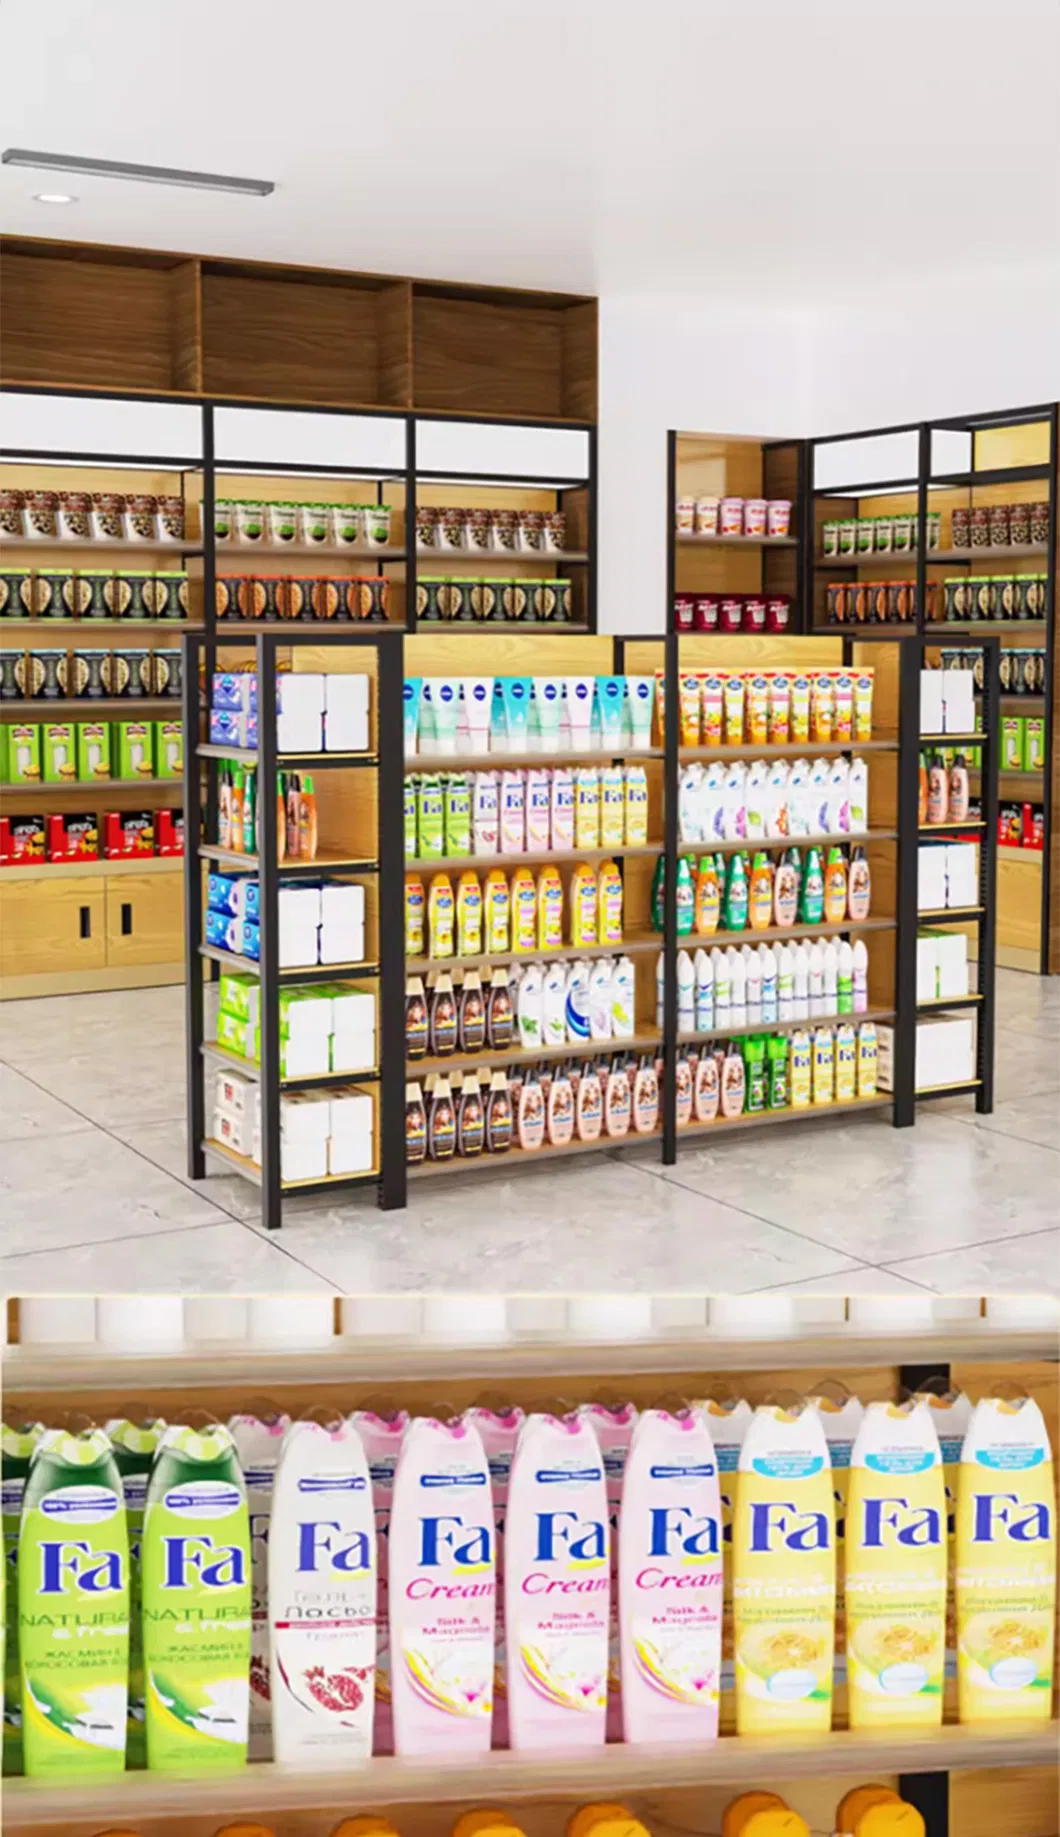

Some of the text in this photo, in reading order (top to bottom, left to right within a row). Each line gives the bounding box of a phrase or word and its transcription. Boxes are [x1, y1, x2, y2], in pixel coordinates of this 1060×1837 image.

[418, 1516, 492, 1567] Fa
[533, 1511, 606, 1562] Fa
[647, 1507, 720, 1557] Fa
[749, 1502, 830, 1552] Fa
[861, 1498, 942, 1547] Fa
[971, 1494, 1051, 1542] Fa
[38, 1542, 123, 1593] Fa
[162, 1536, 246, 1588] Fa
[295, 1521, 372, 1572] Fa
